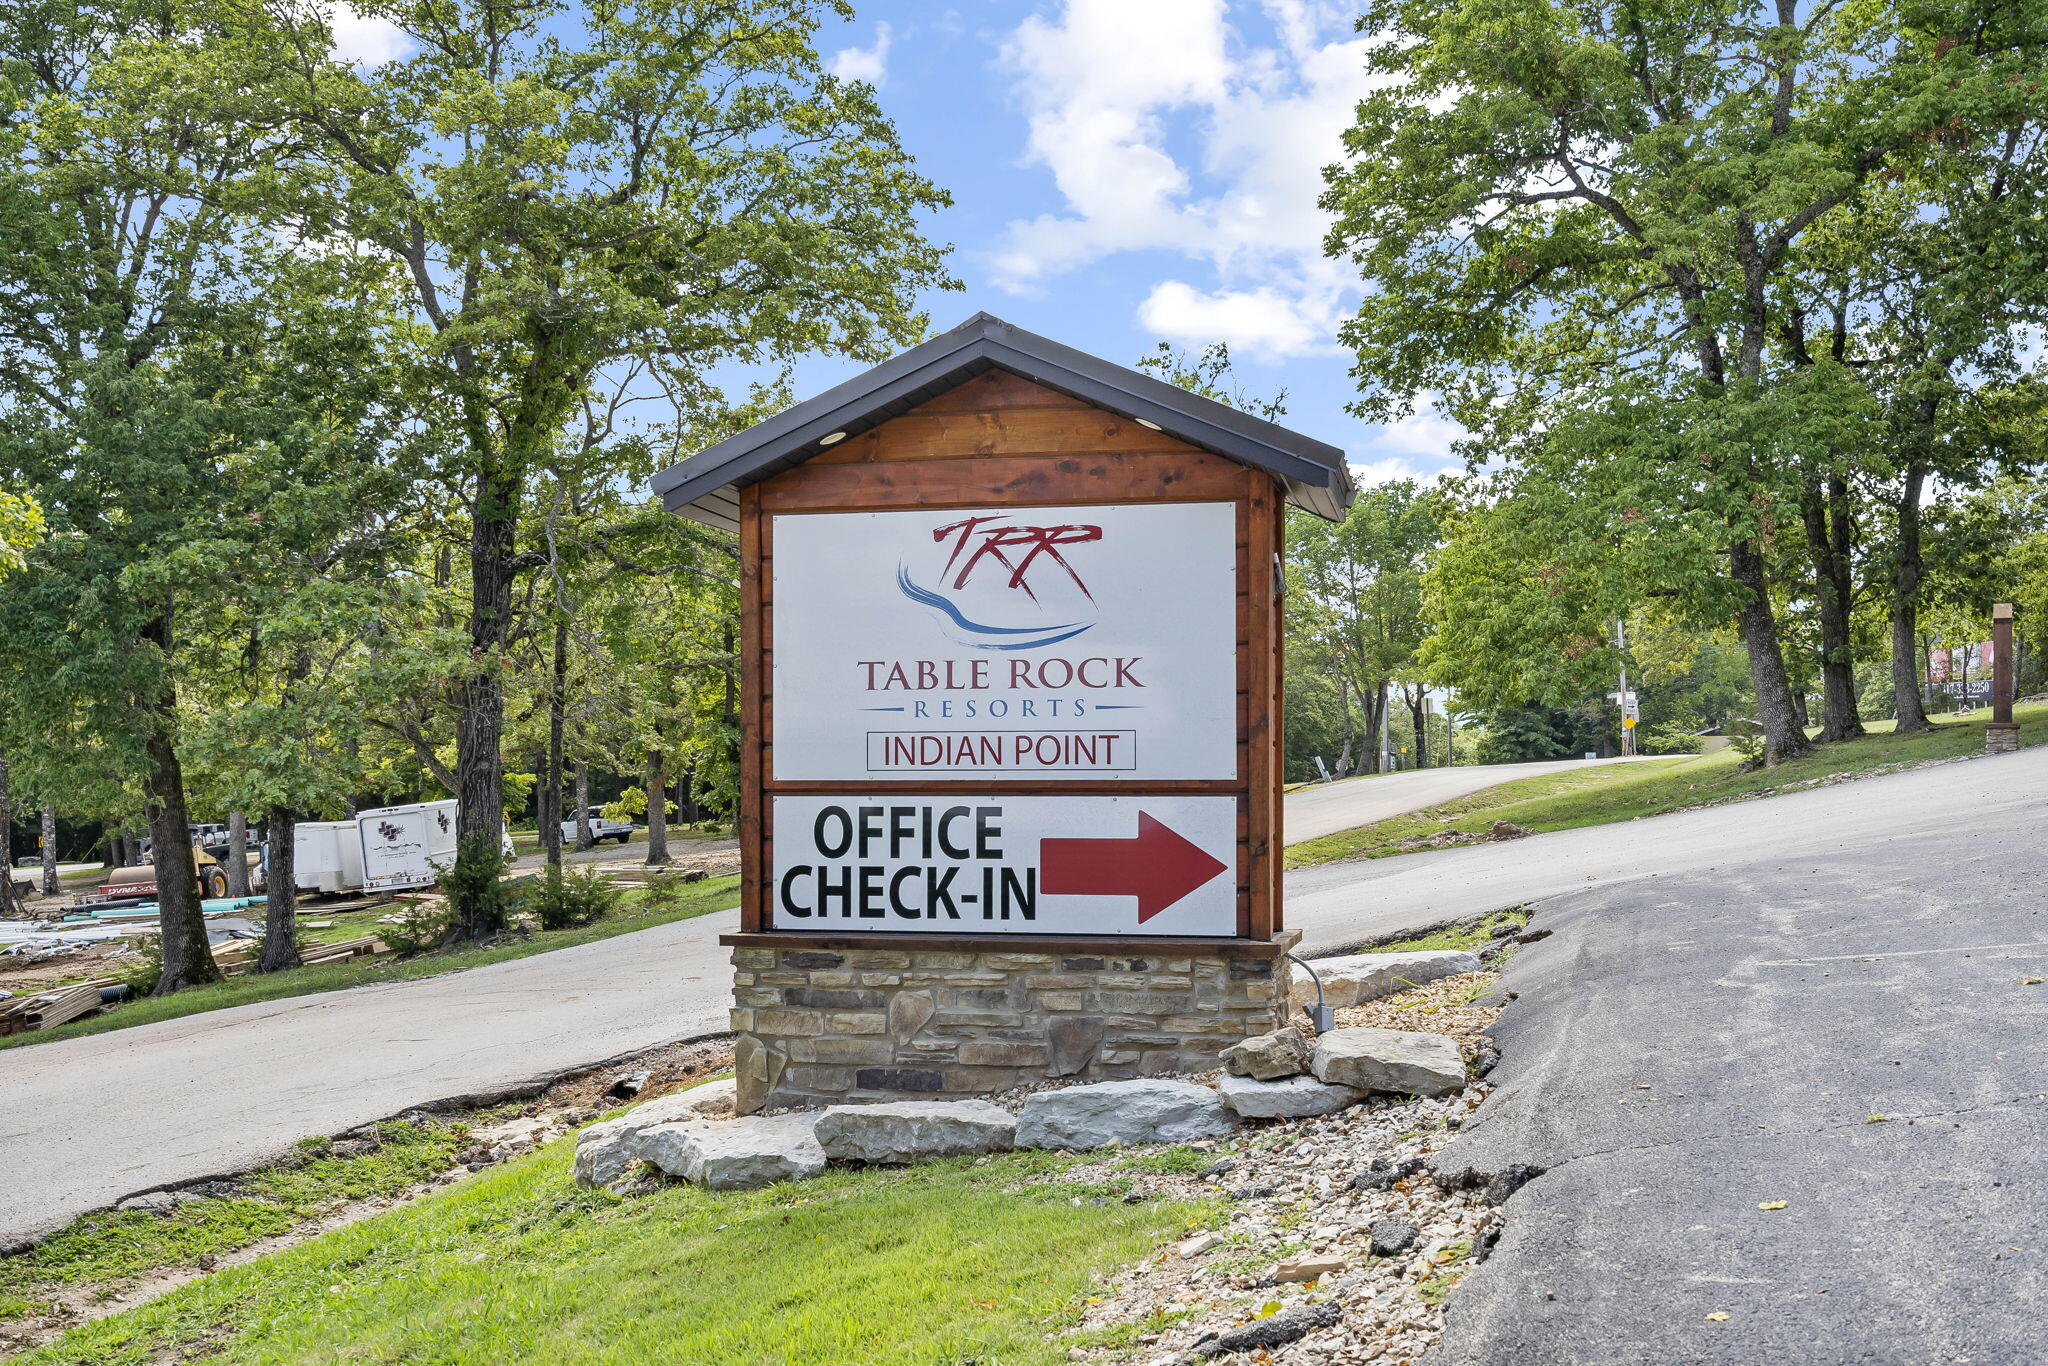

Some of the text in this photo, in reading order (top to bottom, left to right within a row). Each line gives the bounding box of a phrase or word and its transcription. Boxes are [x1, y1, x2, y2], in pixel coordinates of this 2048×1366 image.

[933, 515, 1103, 612] TRR
[857, 657, 1145, 691] TABLE ROCK
[913, 699, 1086, 718] RESORTS
[886, 736, 1118, 765] INDIAN POINT
[814, 806, 1003, 859] OFFICE
[781, 865, 1035, 920] CHECK-IN
